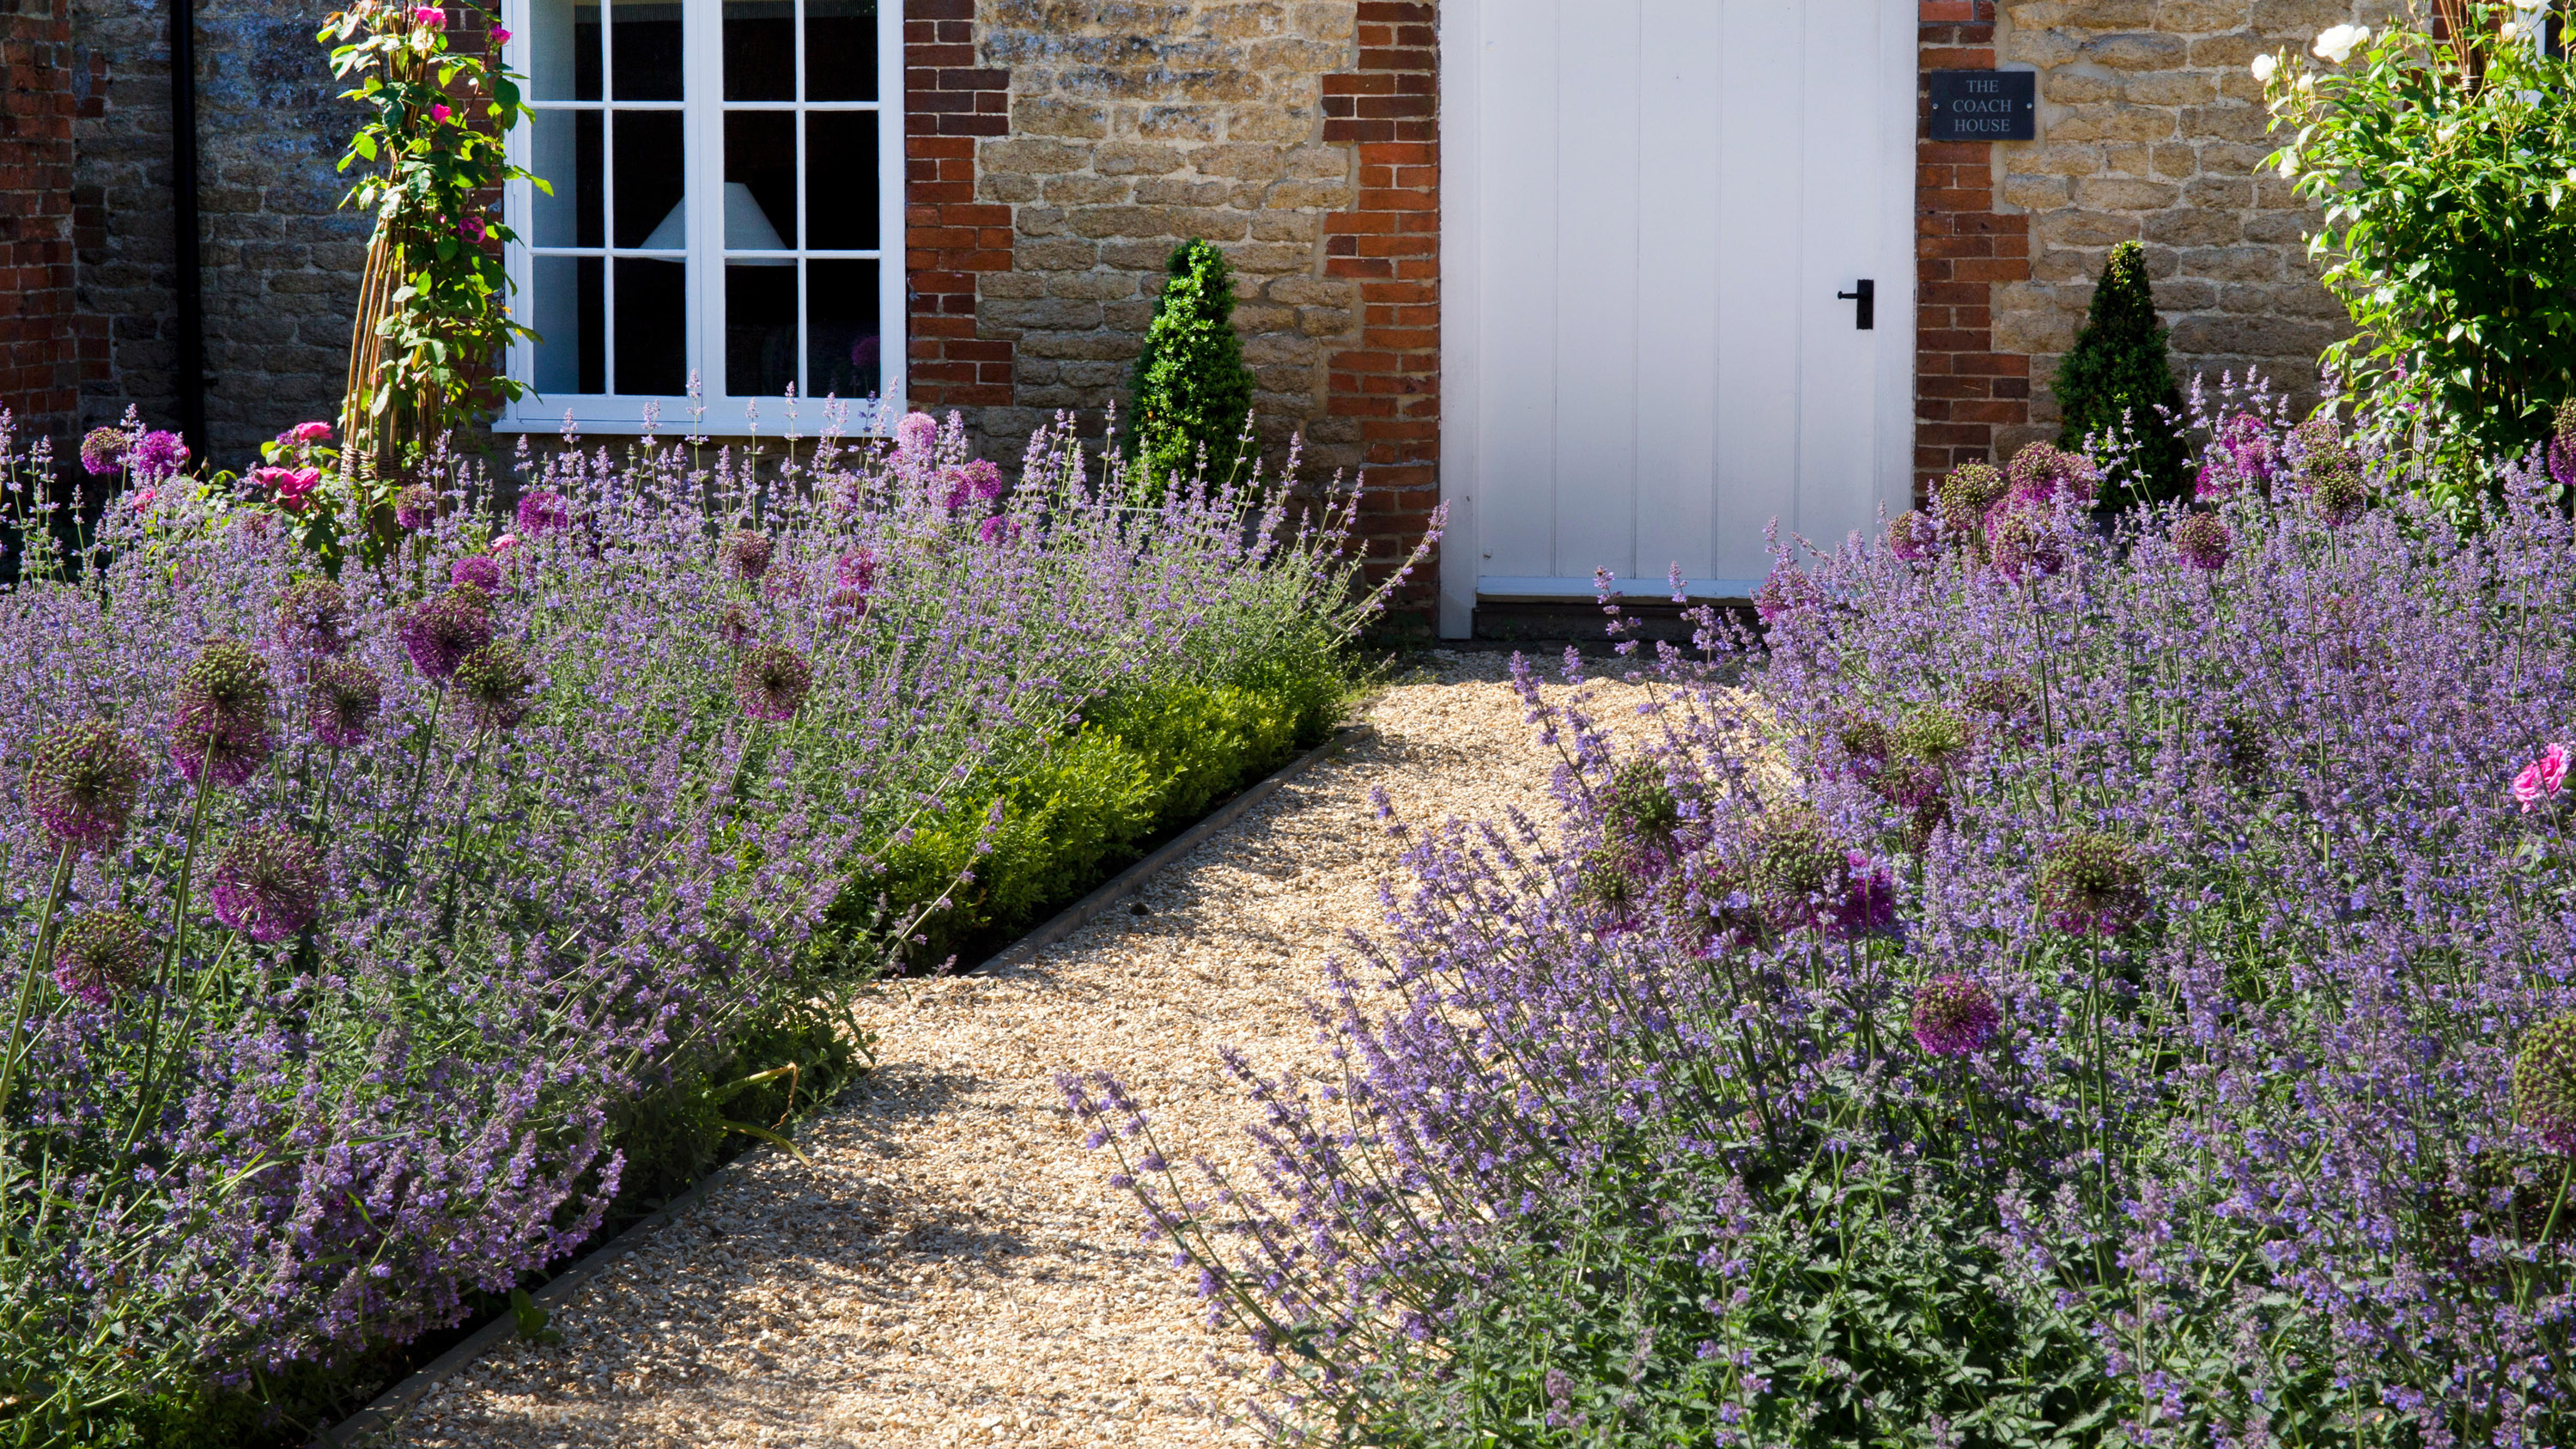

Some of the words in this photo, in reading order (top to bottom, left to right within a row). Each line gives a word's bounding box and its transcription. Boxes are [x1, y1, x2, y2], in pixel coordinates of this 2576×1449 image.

[1966, 80, 1999, 93] THE
[1953, 99, 2012, 113] COACH
[1953, 119, 2011, 131] HOUSE
